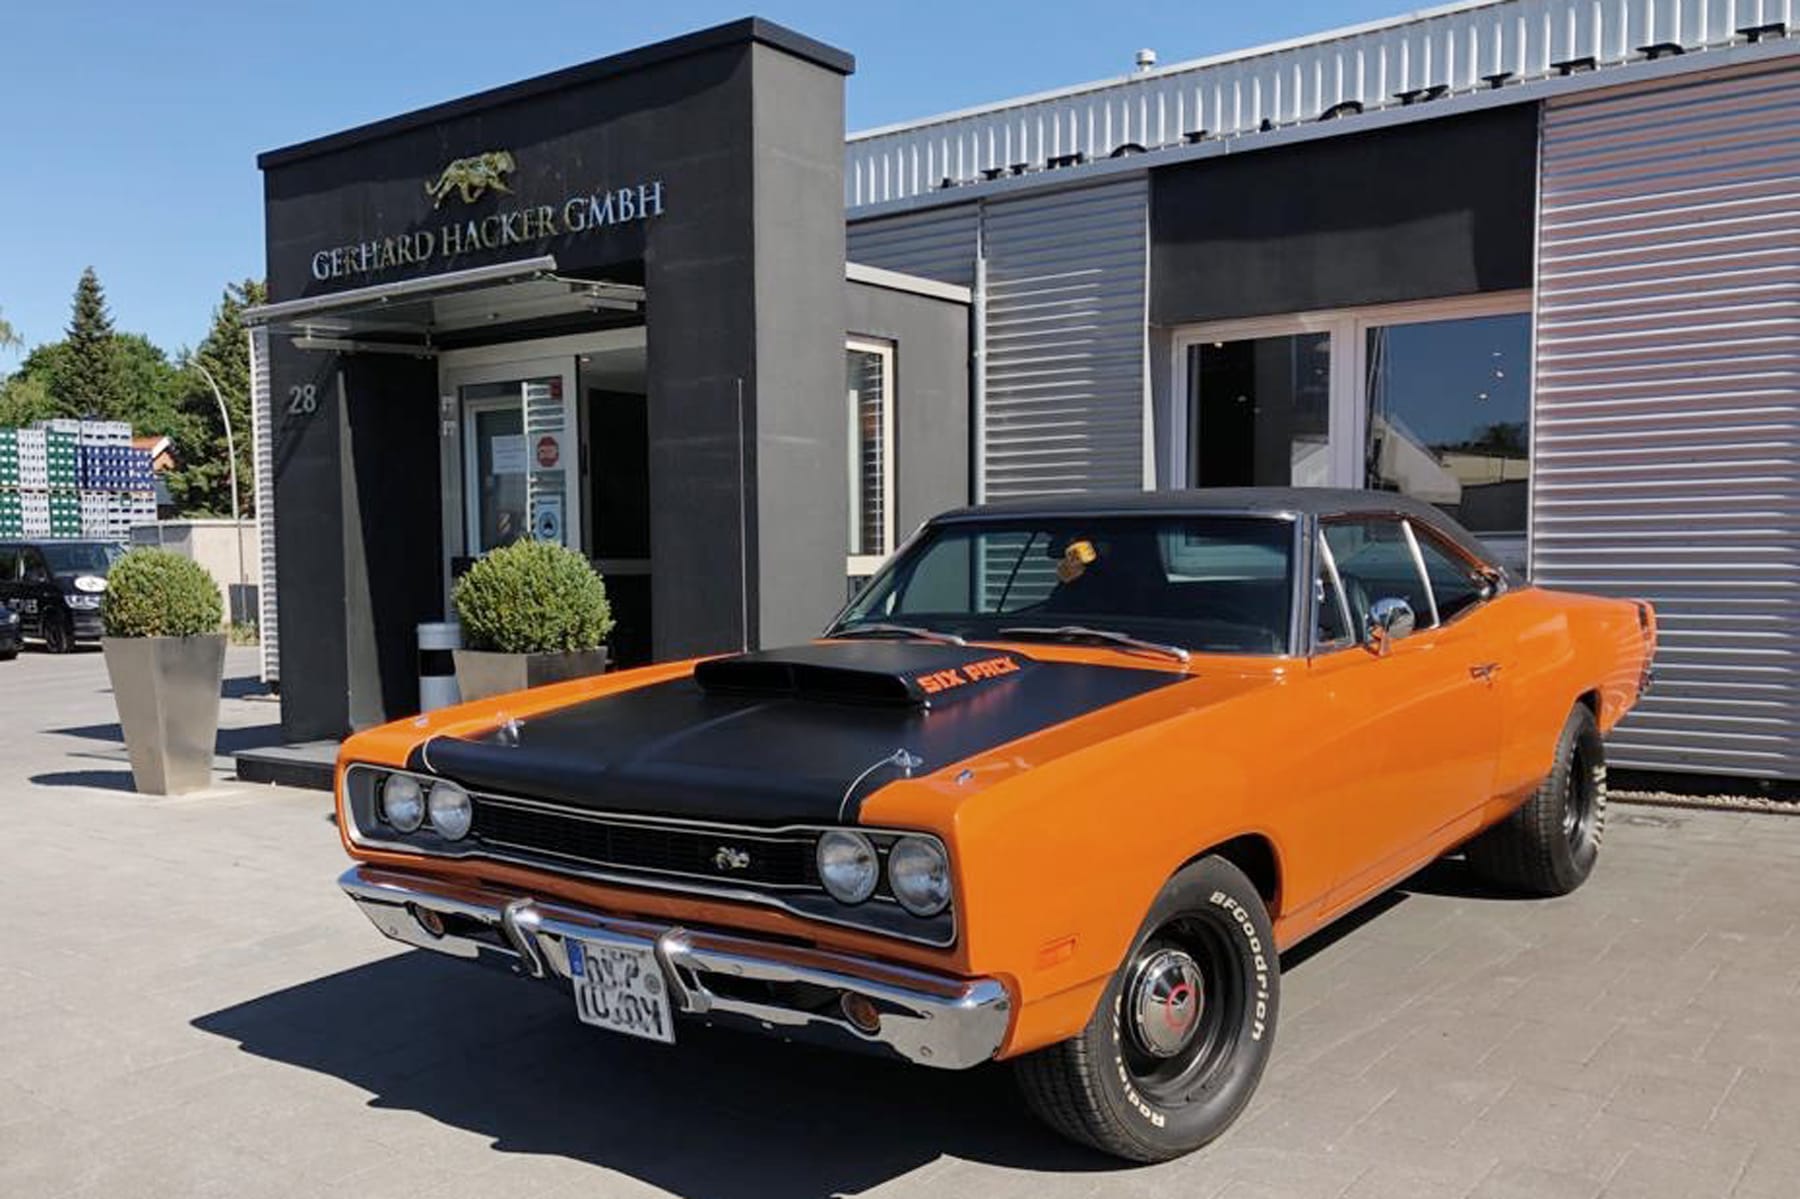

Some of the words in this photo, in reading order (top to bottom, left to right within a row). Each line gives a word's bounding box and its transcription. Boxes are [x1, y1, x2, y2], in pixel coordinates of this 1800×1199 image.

[312, 231, 435, 281] GERHARD
[442, 206, 555, 257] HACKER
[564, 180, 665, 233] GMBH
[289, 384, 317, 415] 28
[917, 668, 965, 693] SIX
[961, 656, 1021, 681] PACK
[1209, 890, 1270, 1042] BFGoodrich
